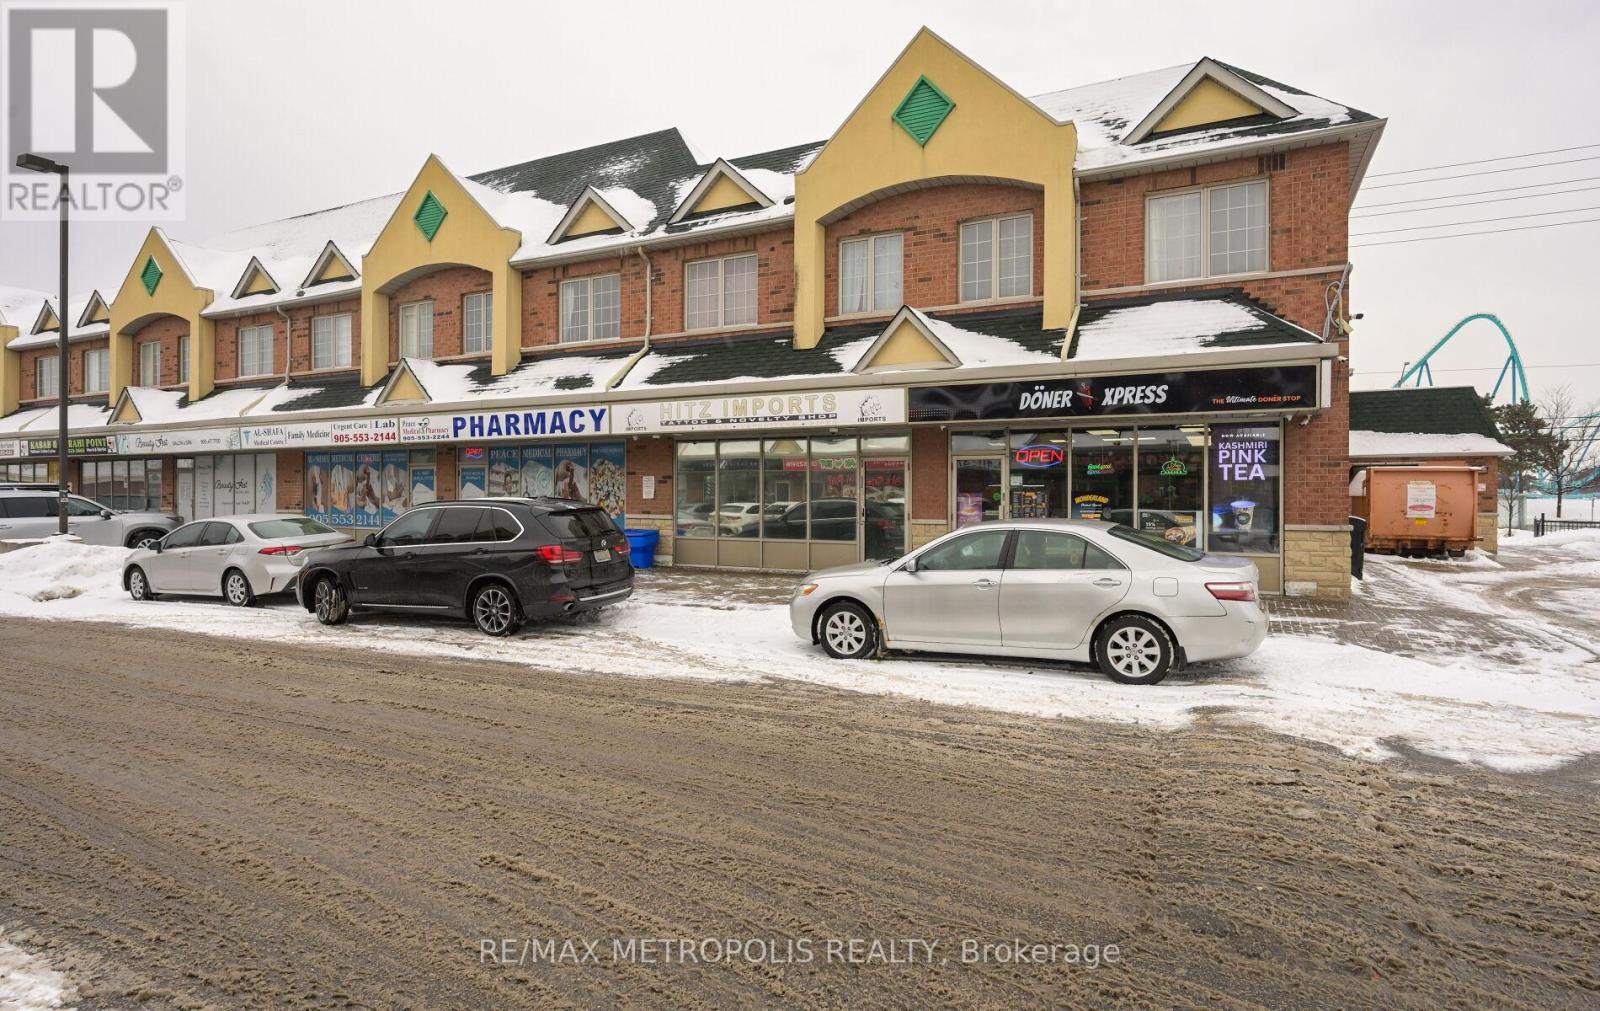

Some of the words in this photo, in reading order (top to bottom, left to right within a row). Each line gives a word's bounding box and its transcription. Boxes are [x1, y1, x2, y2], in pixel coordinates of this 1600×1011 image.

[1018, 385, 1073, 410] DÖNER
[1102, 384, 1169, 406] XPRESS
[1226, 396, 1257, 404] Ultimate
[660, 401, 712, 419] HITZ
[723, 394, 837, 417] IMPORTS
[798, 412, 837, 420] SHOP
[376, 420, 396, 428] Lab
[452, 408, 607, 438] PHARMACY
[254, 428, 284, 436] AL-SHAFA
[288, 431, 306, 440] Family
[306, 430, 330, 438] Medicine
[334, 432, 396, 442] 905-553-2144
[30, 440, 52, 449] KABAB
[86, 438, 106, 448] POINT
[1218, 441, 1268, 450] KASHMIRI
[490, 450, 518, 458] PEACE
[522, 448, 552, 458] MEDICAL
[556, 448, 588, 457] PHARMACY
[1016, 449, 1065, 462] OPEN
[1218, 449, 1267, 464] PINK
[1219, 464, 1266, 480] TEA
[332, 514, 354, 525] 553
[356, 514, 380, 526] 2144
